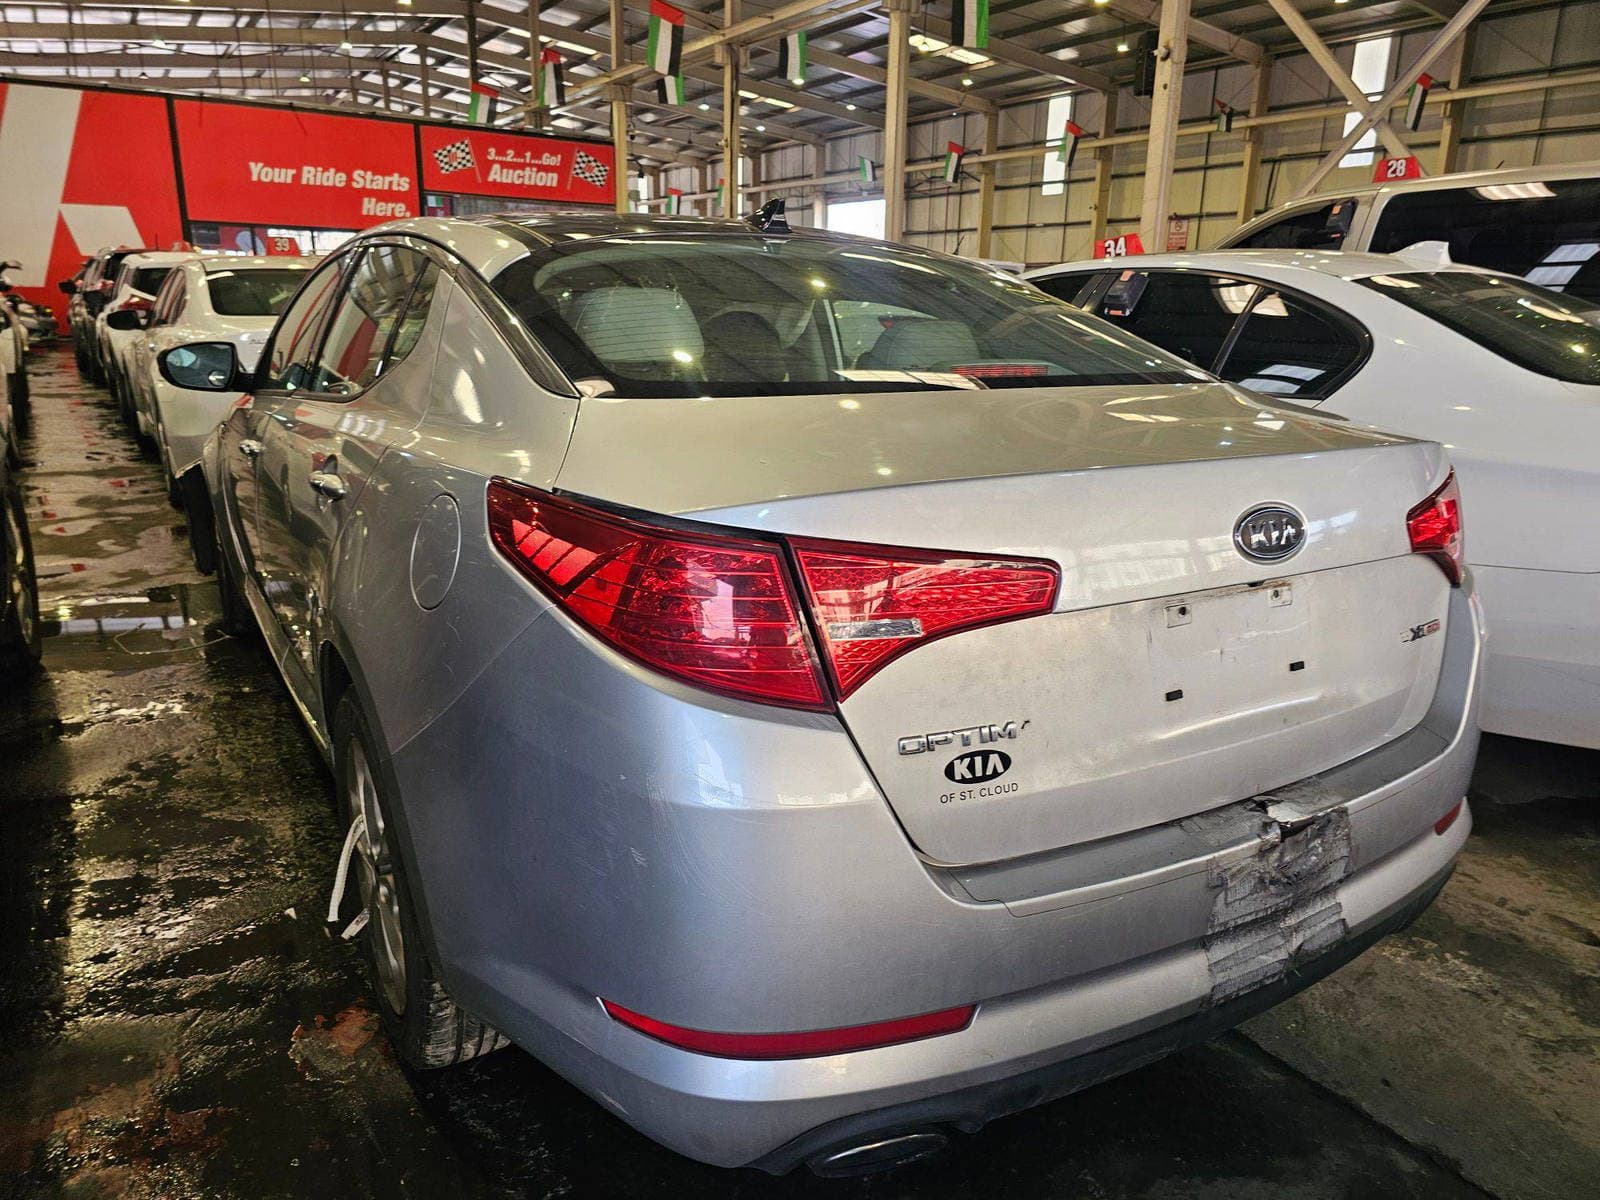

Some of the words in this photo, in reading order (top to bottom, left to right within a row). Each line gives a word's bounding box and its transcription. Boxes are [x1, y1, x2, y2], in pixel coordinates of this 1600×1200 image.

[249, 162, 297, 184] Your
[301, 166, 347, 187] Ride
[352, 170, 411, 191] Starts
[487, 164, 559, 187] Auction
[1387, 159, 1407, 178] 28
[362, 197, 411, 217] Here.
[273, 238, 290, 252] 39
[1105, 236, 1127, 258] 34
[897, 720, 1030, 756] OPTIM
[953, 753, 1004, 780] KIA
[939, 792, 956, 804] OF
[959, 789, 976, 801] ST.
[979, 782, 1019, 798] CLOUD
